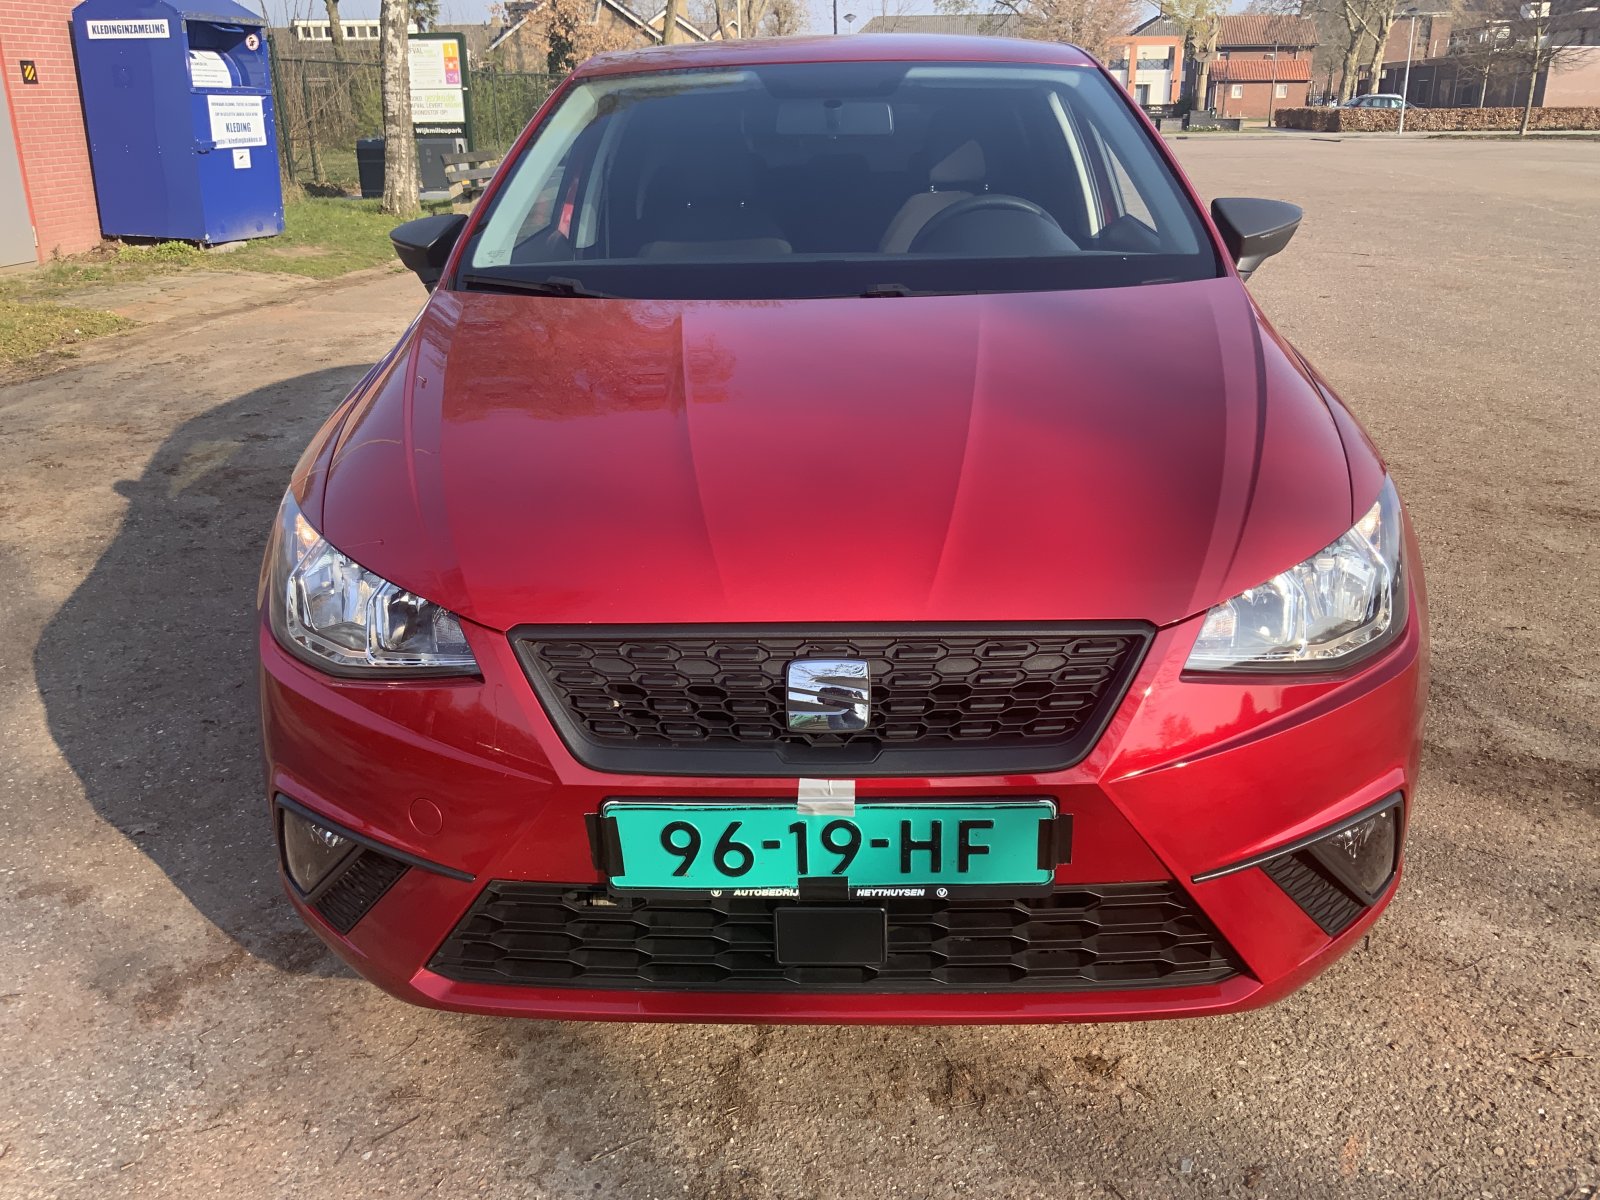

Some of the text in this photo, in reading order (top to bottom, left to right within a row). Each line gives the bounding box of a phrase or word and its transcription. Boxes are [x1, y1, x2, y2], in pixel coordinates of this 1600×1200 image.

[91, 23, 166, 35] KLEDINGINZAMELING
[225, 122, 252, 133] KLEDING
[415, 127, 462, 135] Wijkmilieupark
[659, 819, 996, 877] 96-19-HF
[733, 888, 799, 897] AUTOBEDRIJ
[856, 888, 926, 897] HEYTHUYSEN
